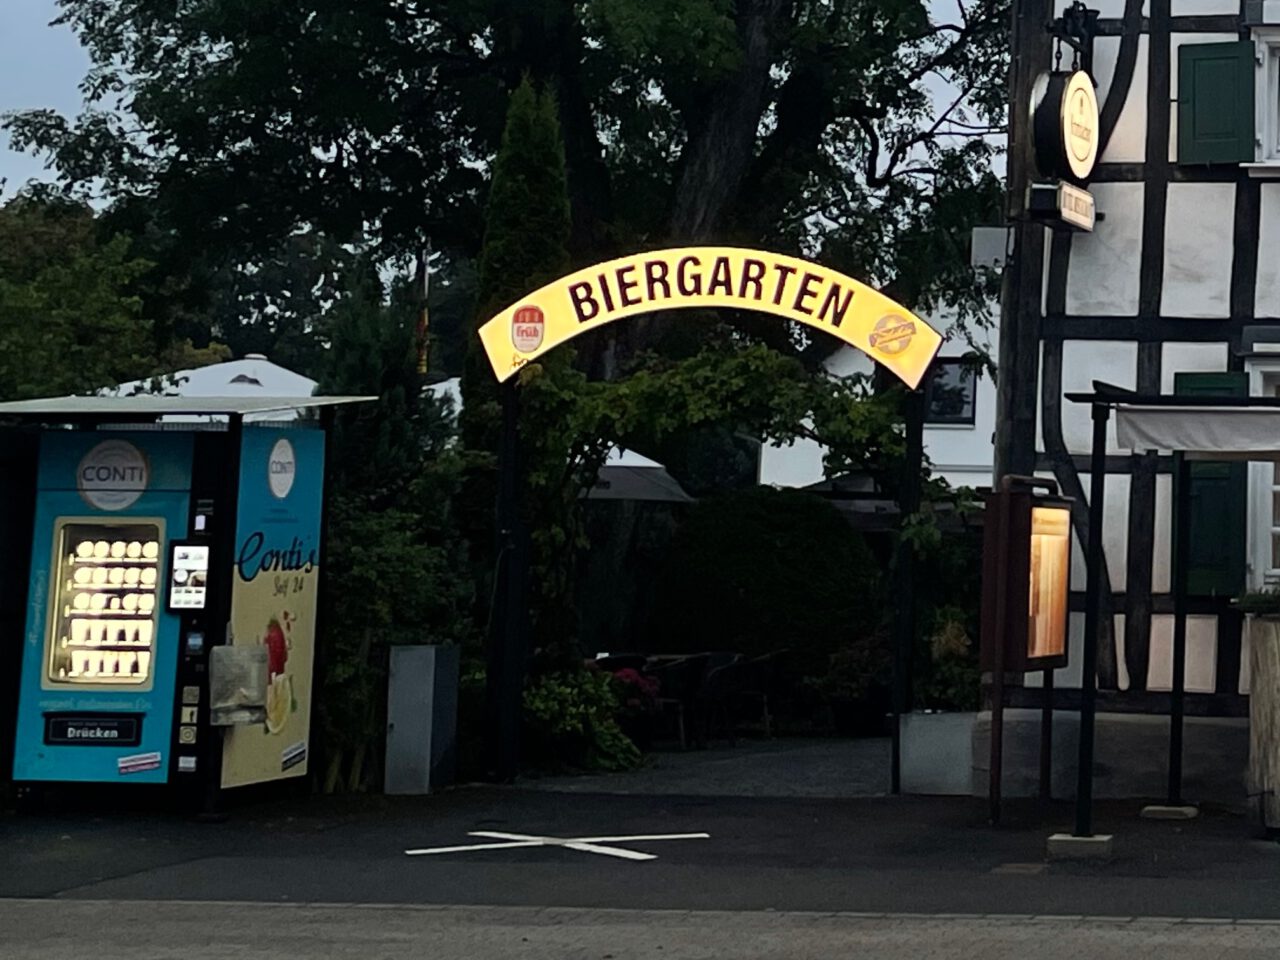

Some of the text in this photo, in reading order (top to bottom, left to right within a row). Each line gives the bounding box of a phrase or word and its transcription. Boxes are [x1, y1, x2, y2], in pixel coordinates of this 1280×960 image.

[566, 255, 855, 329] BIERGARTEN
[82, 465, 144, 482] CONTI
[270, 459, 294, 475] CONTI
[66, 726, 119, 739] Drücken
